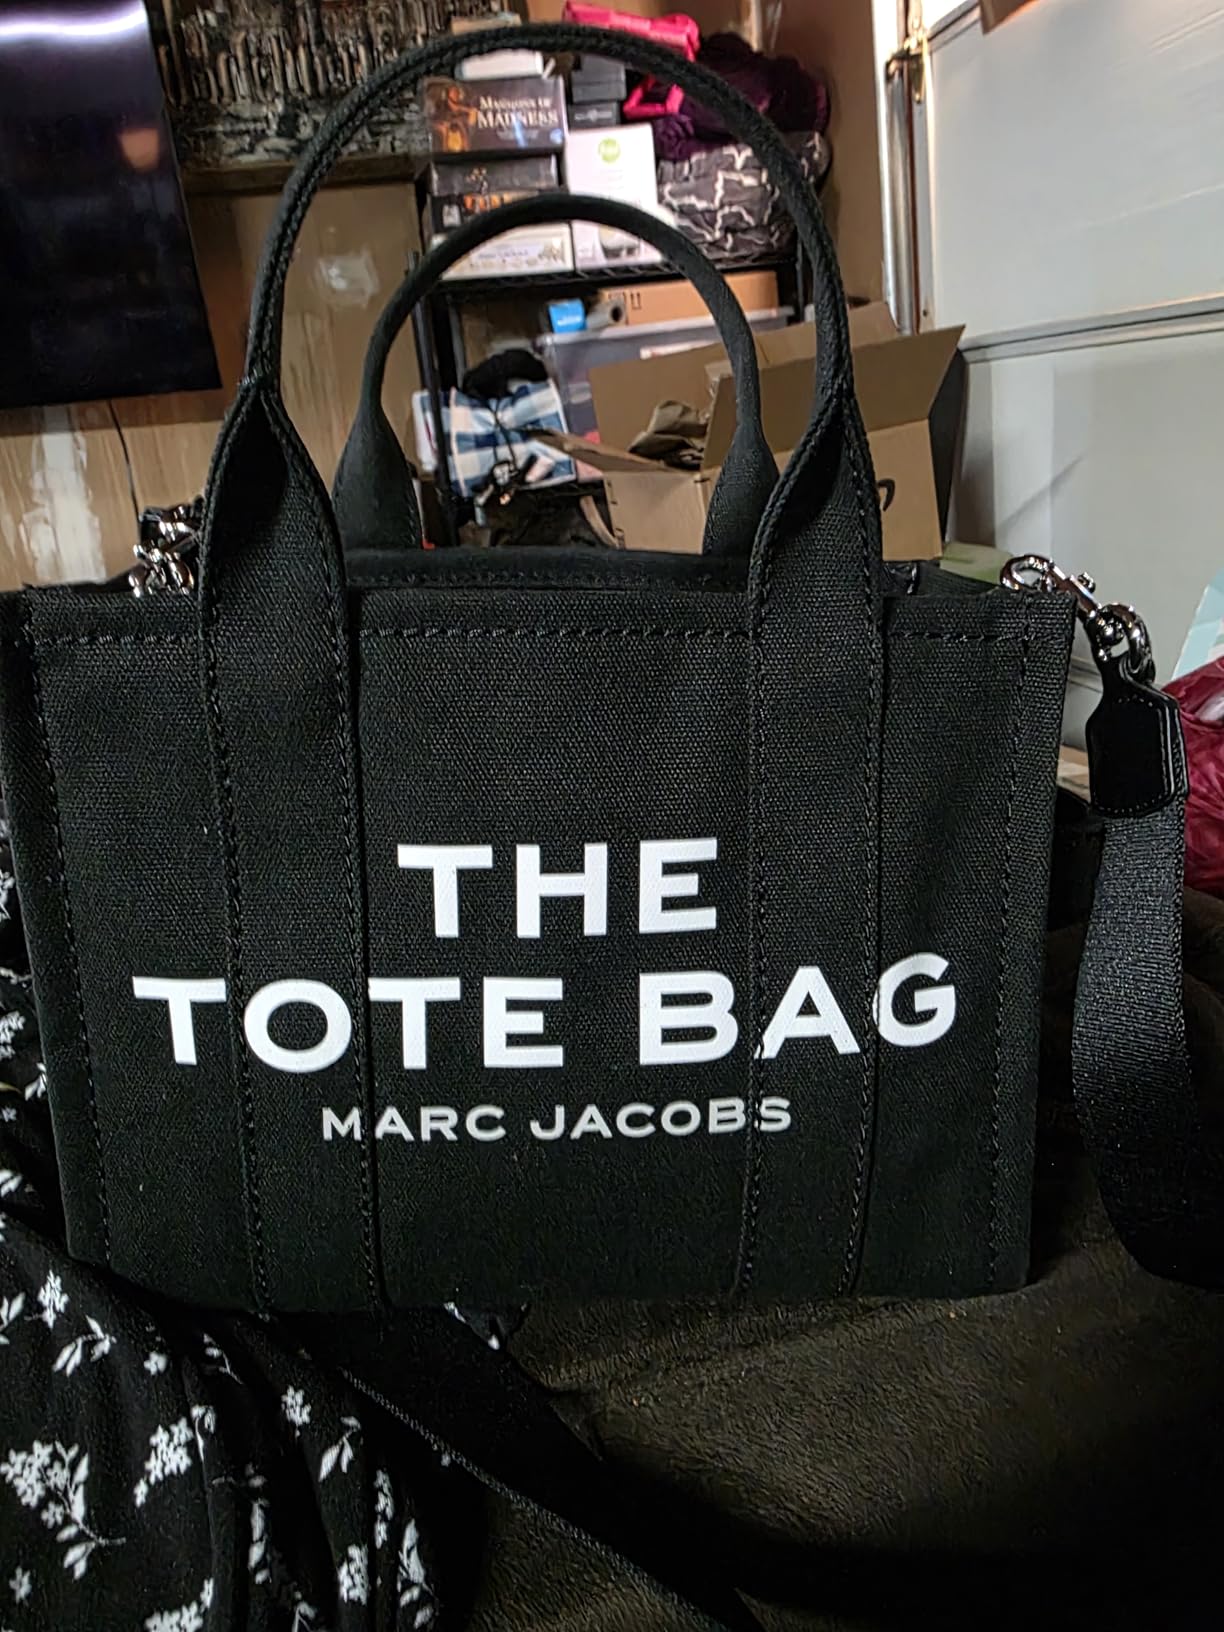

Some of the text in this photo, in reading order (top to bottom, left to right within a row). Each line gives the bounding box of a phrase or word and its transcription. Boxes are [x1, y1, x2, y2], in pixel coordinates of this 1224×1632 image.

[478, 109, 559, 129] MADNESS
[397, 837, 719, 939] THE
[132, 953, 957, 1073] TOTE BAG
[322, 1097, 792, 1142] MARC JACOBS
